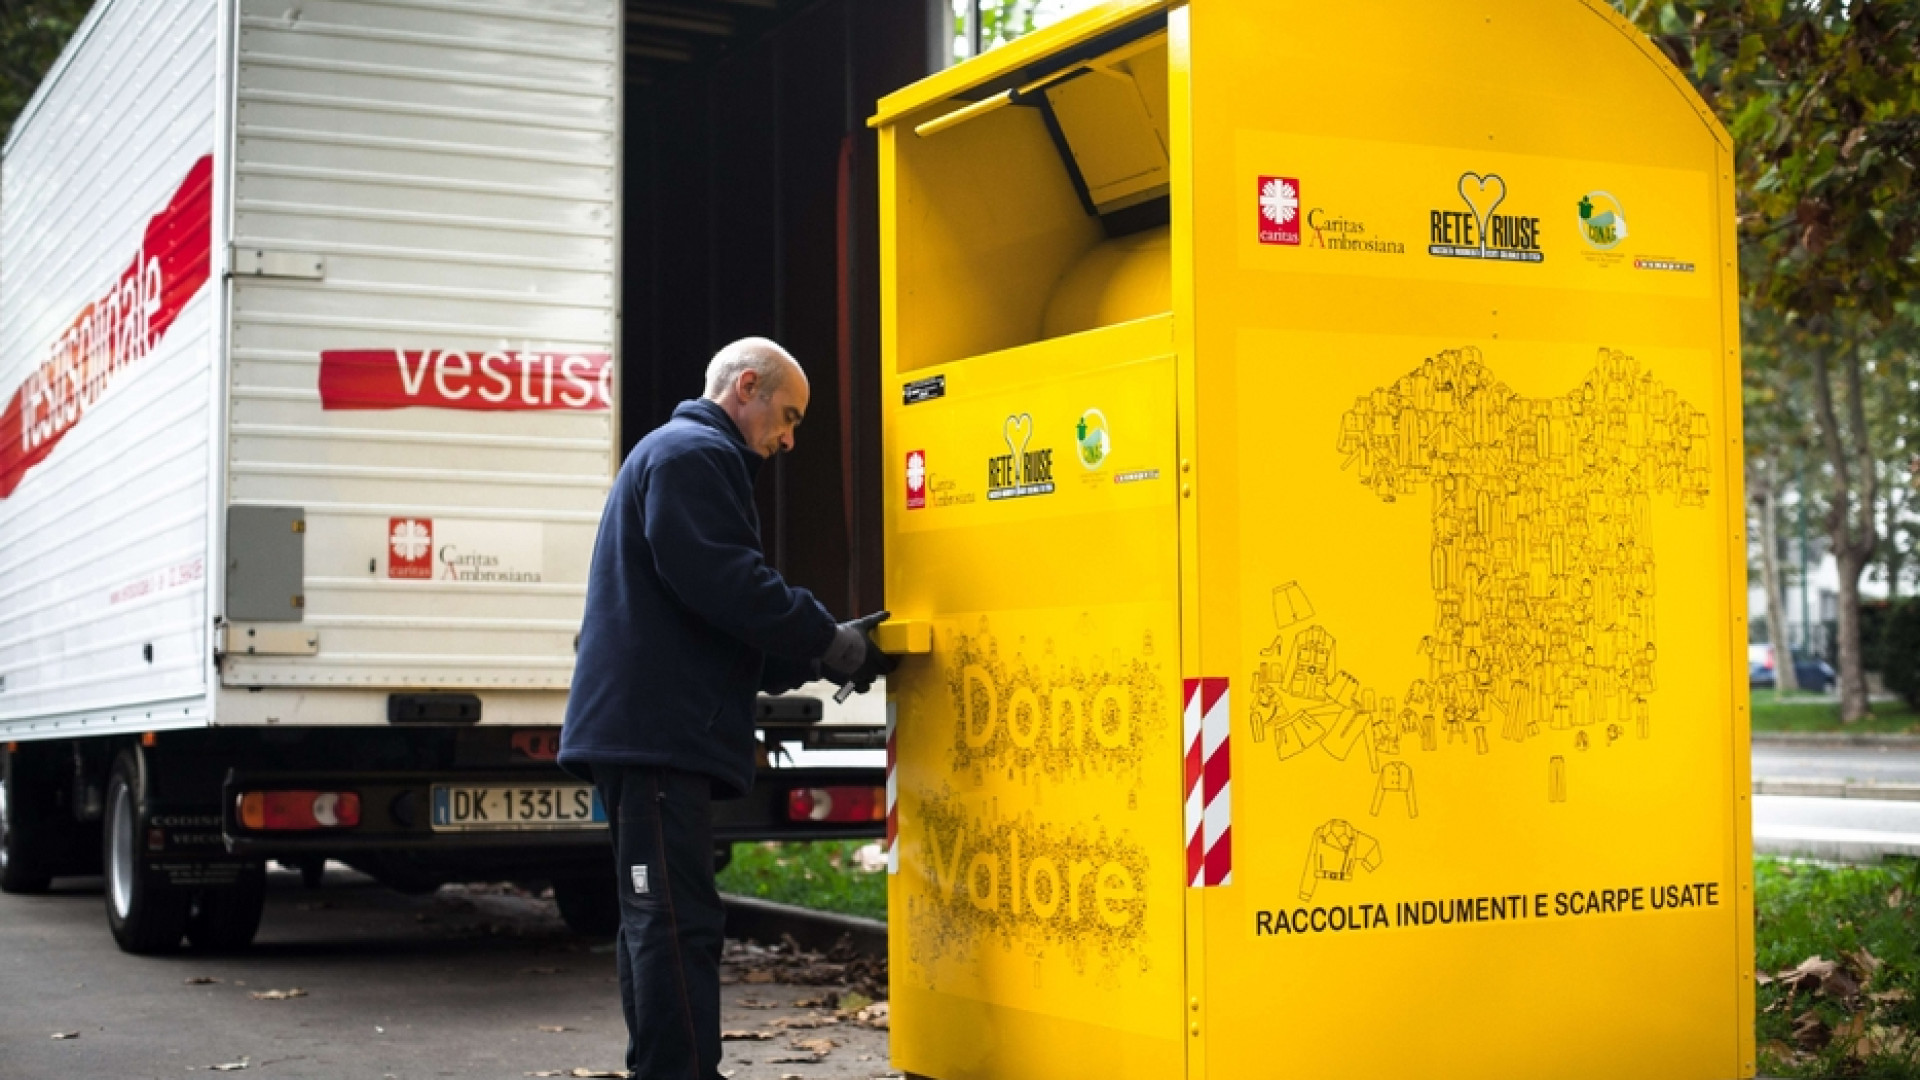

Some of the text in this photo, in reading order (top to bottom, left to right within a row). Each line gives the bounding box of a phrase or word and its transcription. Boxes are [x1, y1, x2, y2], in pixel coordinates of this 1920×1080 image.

[1307, 208, 1365, 233] Caritas
[1431, 210, 1541, 249] RETE RIUSE
[1308, 226, 1405, 253] Ambrosiana
[988, 455, 1012, 488] RETE
[439, 545, 499, 566] Caritas
[441, 562, 541, 582] Ambrosiana
[963, 663, 1130, 749] Dona
[454, 790, 488, 820] DK
[504, 789, 589, 819] 133LS
[928, 827, 1137, 927] Valore
[1256, 881, 1719, 935] RACCOLTA INDUMENTI E SCARPE USATE
